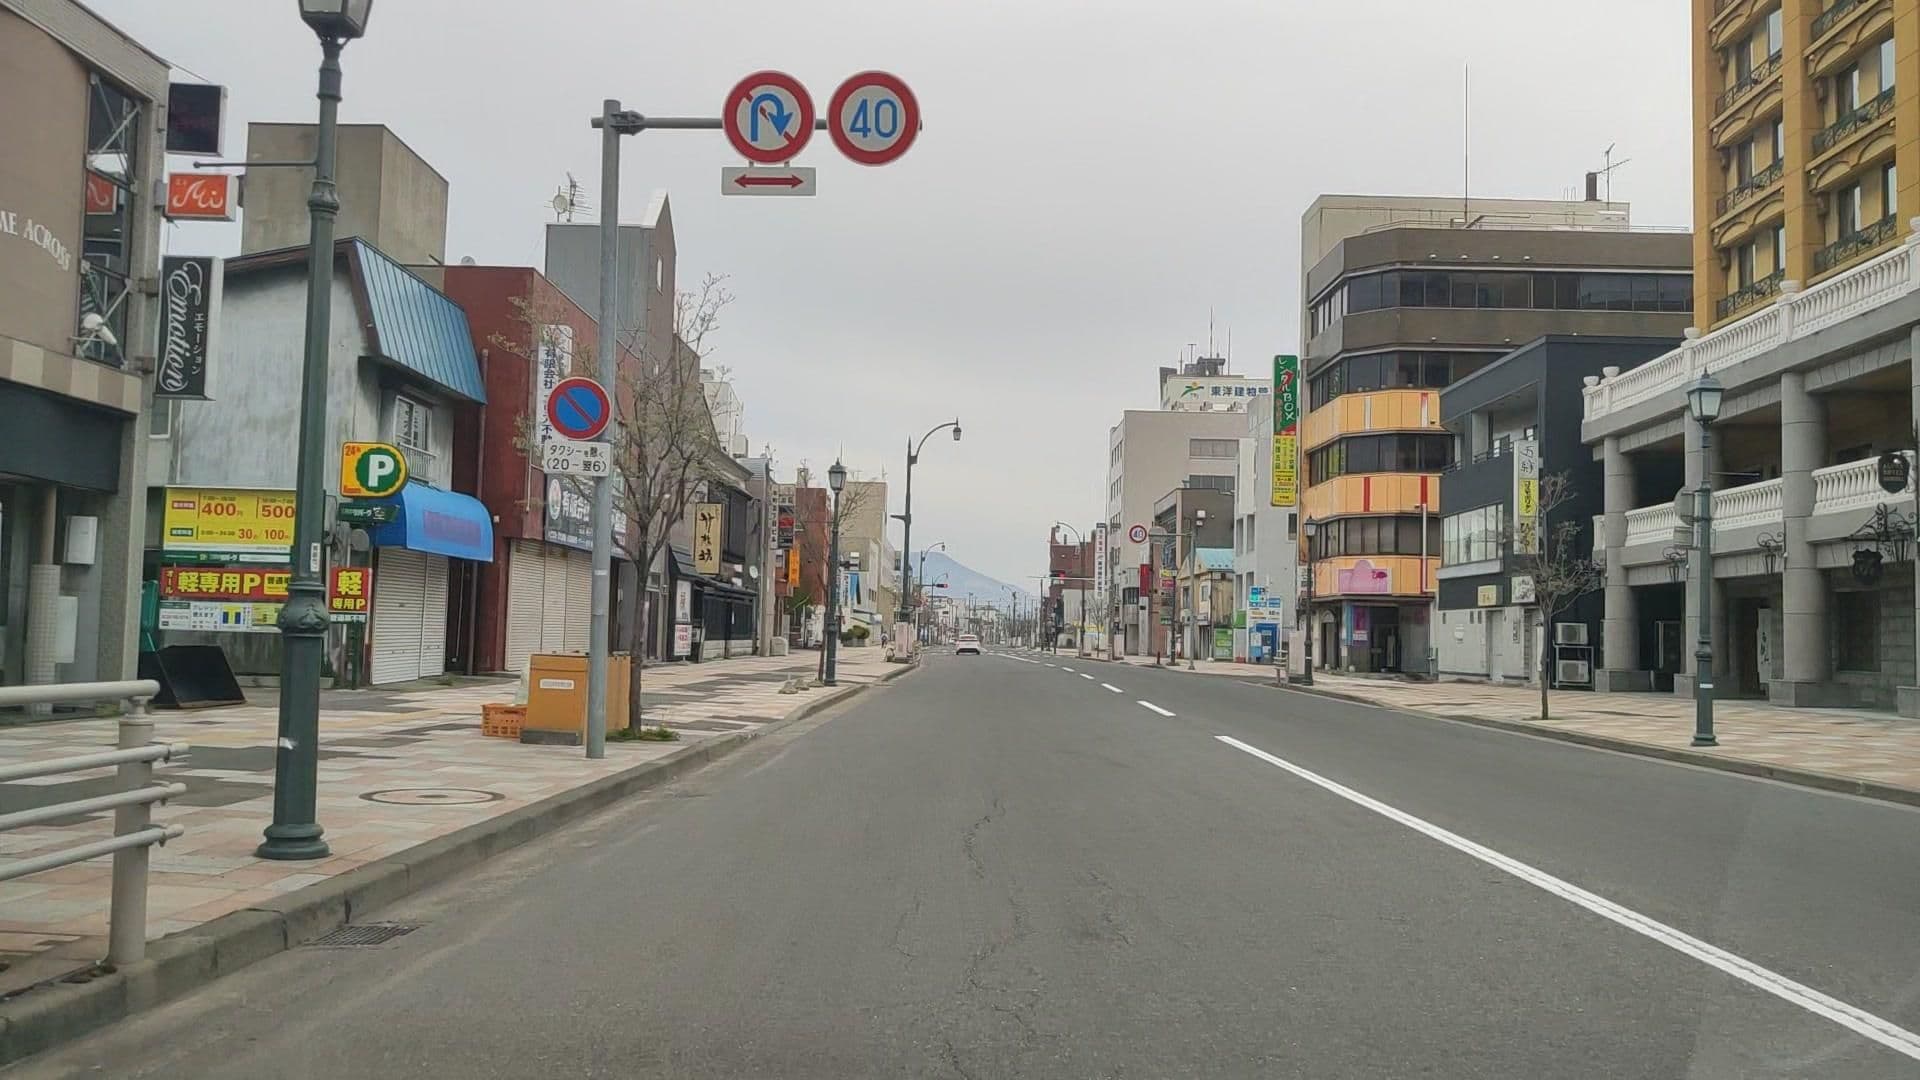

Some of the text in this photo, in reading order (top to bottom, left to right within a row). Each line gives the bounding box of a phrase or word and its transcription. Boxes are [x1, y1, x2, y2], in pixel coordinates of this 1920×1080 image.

[849, 98, 898, 138] 40
[23, 218, 71, 271] ACROSS
[160, 261, 203, 391] Emotion
[192, 313, 205, 374] エモーション
[367, 454, 395, 487] P
[178, 571, 261, 594] 軽専用P
[337, 571, 362, 595] 軽
[332, 597, 366, 610] 専用P
